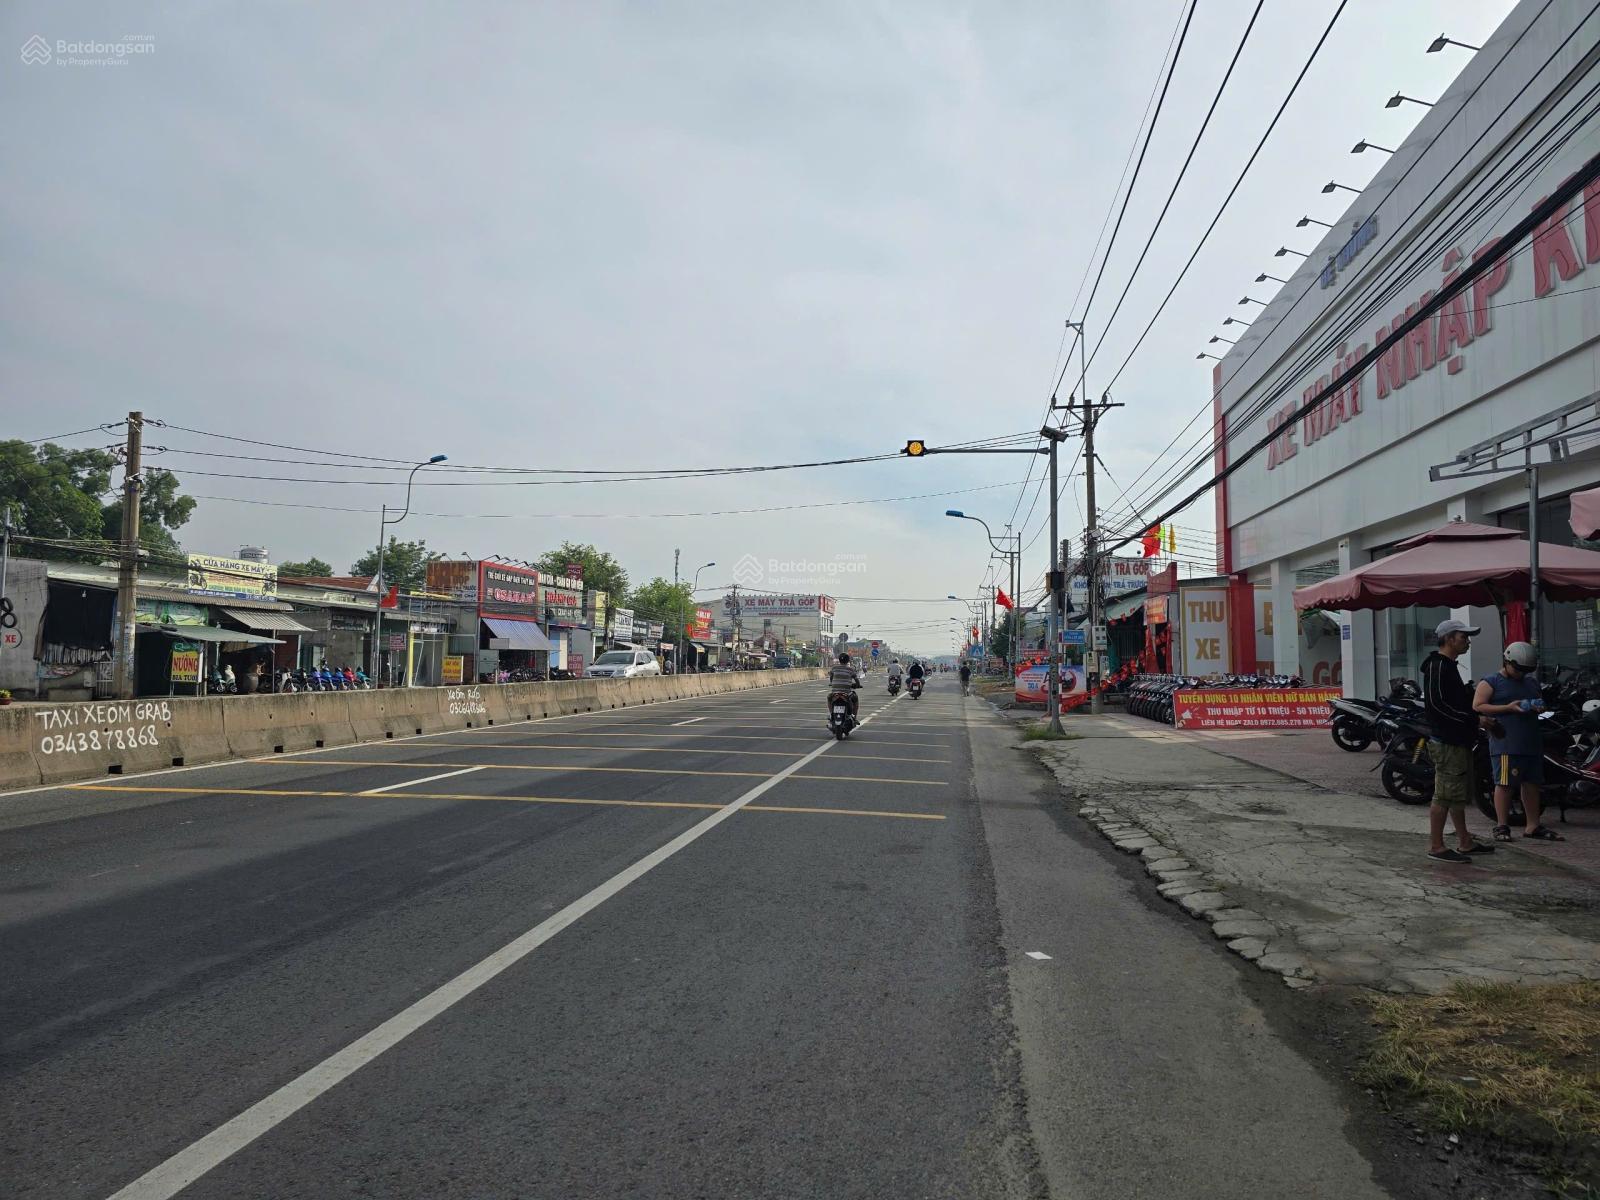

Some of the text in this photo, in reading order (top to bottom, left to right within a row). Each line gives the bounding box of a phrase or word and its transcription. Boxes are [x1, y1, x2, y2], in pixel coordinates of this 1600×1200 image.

[1267, 401, 1298, 471] XE
[1303, 342, 1368, 447] MÁY
[1376, 234, 1512, 400] NHẬP
[220, 560, 240, 570] HÀNG
[251, 563, 266, 573] MÁY
[744, 596, 815, 606] XE MÁY TRẢ GÓP
[1188, 601, 1225, 623] THU
[5, 634, 16, 643] XE
[1195, 638, 1221, 660] XE
[1178, 691, 1203, 703] TUYỂN
[1205, 694, 1227, 705] DỤNG
[1229, 694, 1238, 703] 10
[1240, 692, 1263, 703] NHÂN
[1264, 692, 1283, 702] VIÊN
[1286, 691, 1297, 702] NỮ
[1299, 692, 1317, 702] BÁN
[83, 704, 131, 724] XEOM
[135, 702, 171, 721] GRAB
[1207, 707, 1221, 715] THU
[1222, 705, 1243, 717] NHẬP
[1245, 706, 1255, 715] TỪ
[1257, 707, 1266, 715] 10
[1268, 705, 1289, 717] TRIỆU
[1297, 707, 1306, 715] 50
[1308, 705, 1330, 717] TRIỆU
[1201, 718, 1215, 726] LIÊN
[1216, 718, 1225, 727] HỆ
[41, 725, 158, 754] 0343878868
